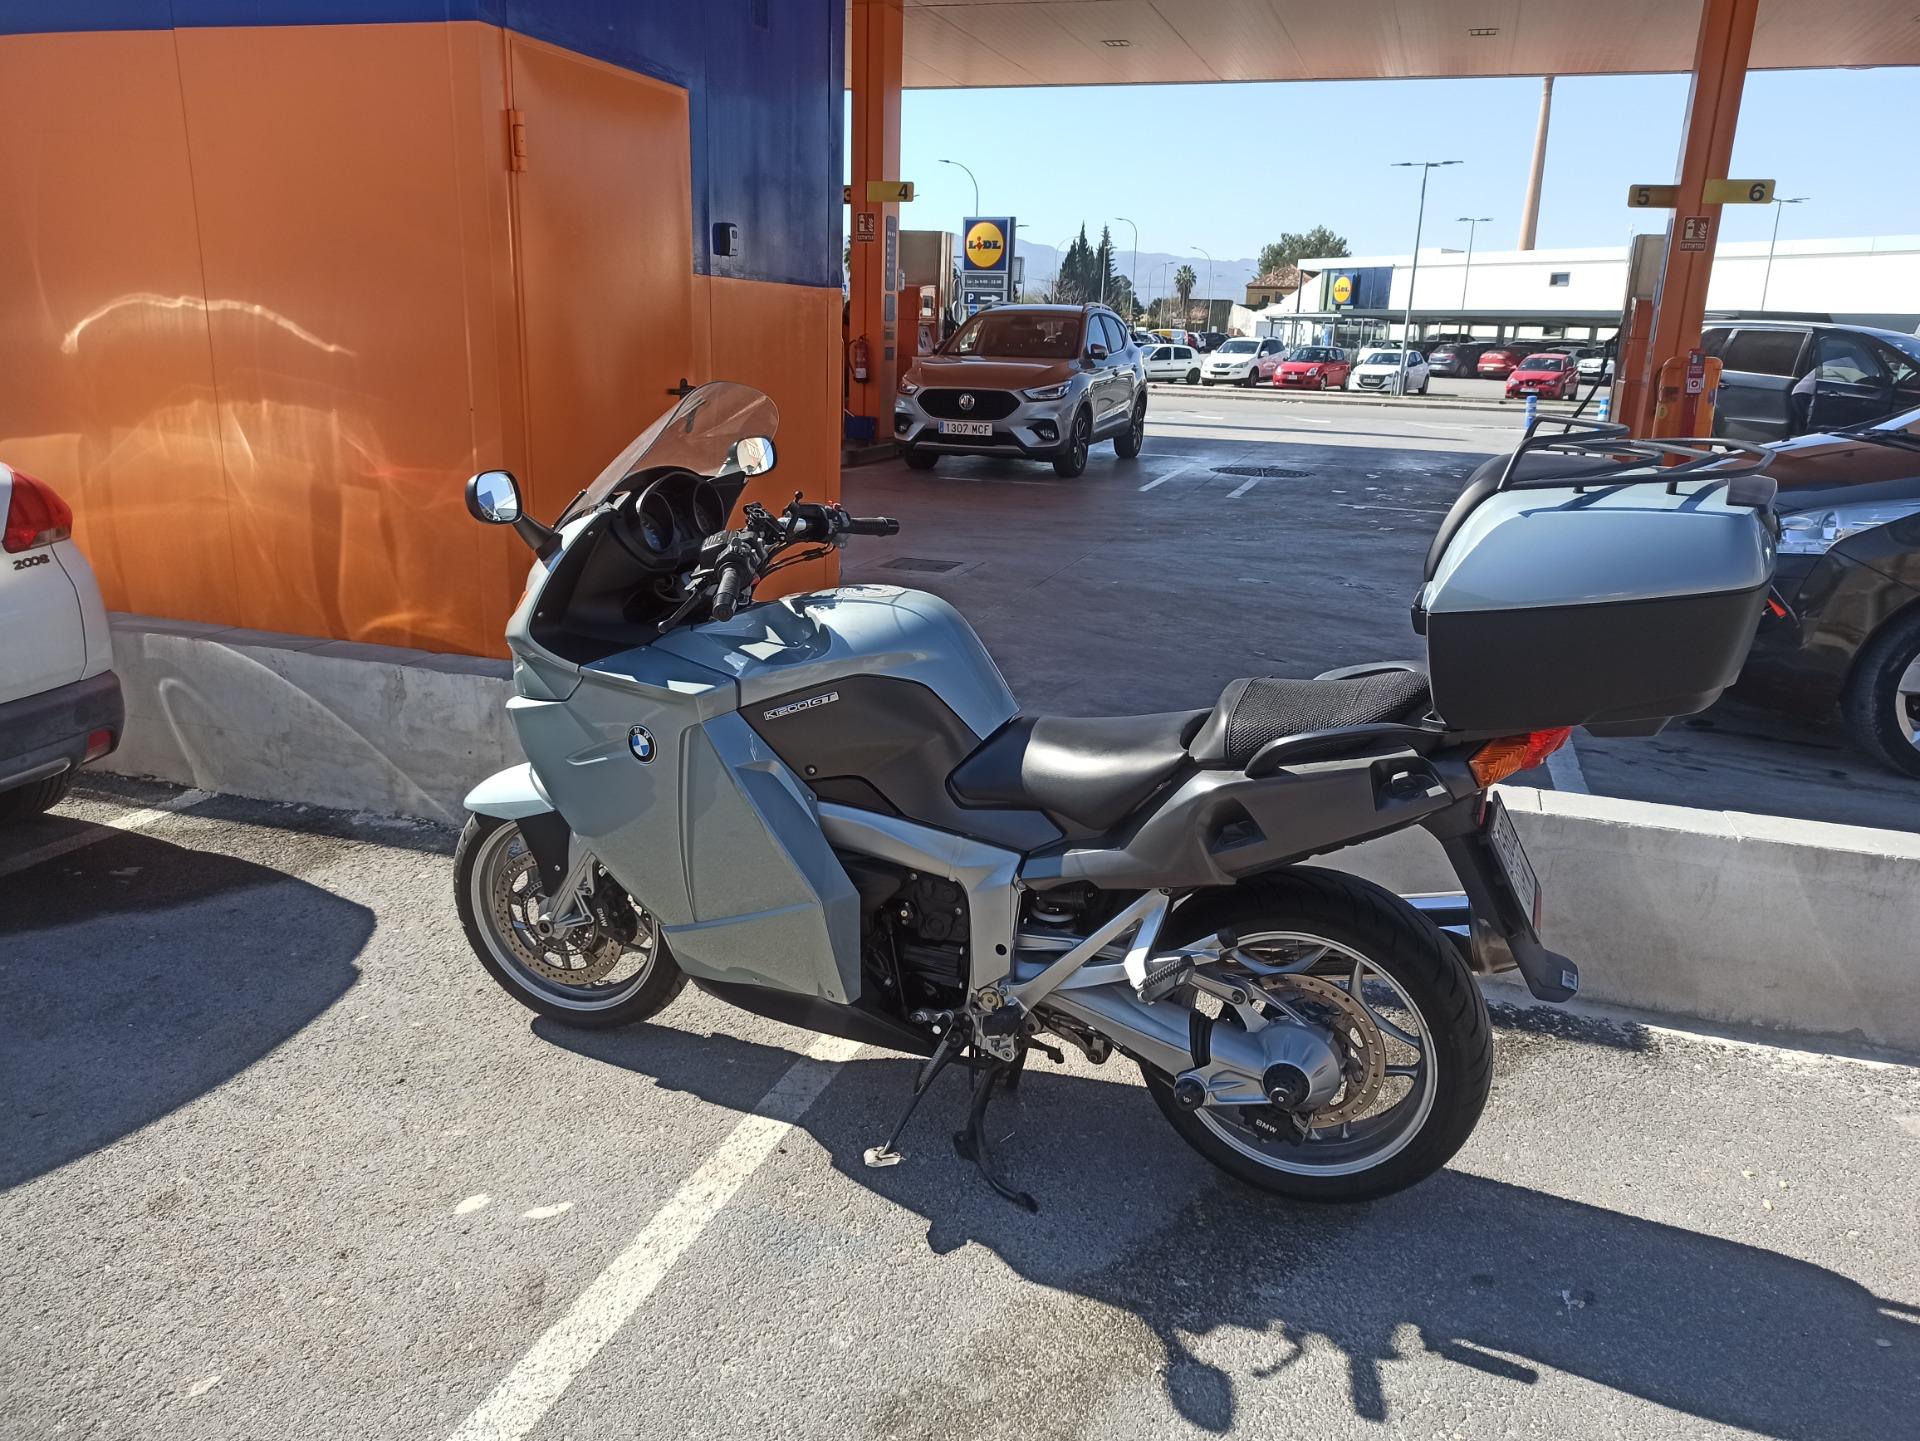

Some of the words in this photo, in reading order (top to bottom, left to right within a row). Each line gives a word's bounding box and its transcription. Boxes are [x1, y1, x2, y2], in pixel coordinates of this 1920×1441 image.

[897, 183, 908, 199] 4
[1636, 188, 1650, 206] 5
[1749, 183, 1765, 202] 6
[967, 293, 975, 303] P
[945, 423, 968, 434] 1307
[972, 424, 989, 435] MCF
[13, 554, 50, 570] 2008
[1255, 1118, 1278, 1134] BMW
